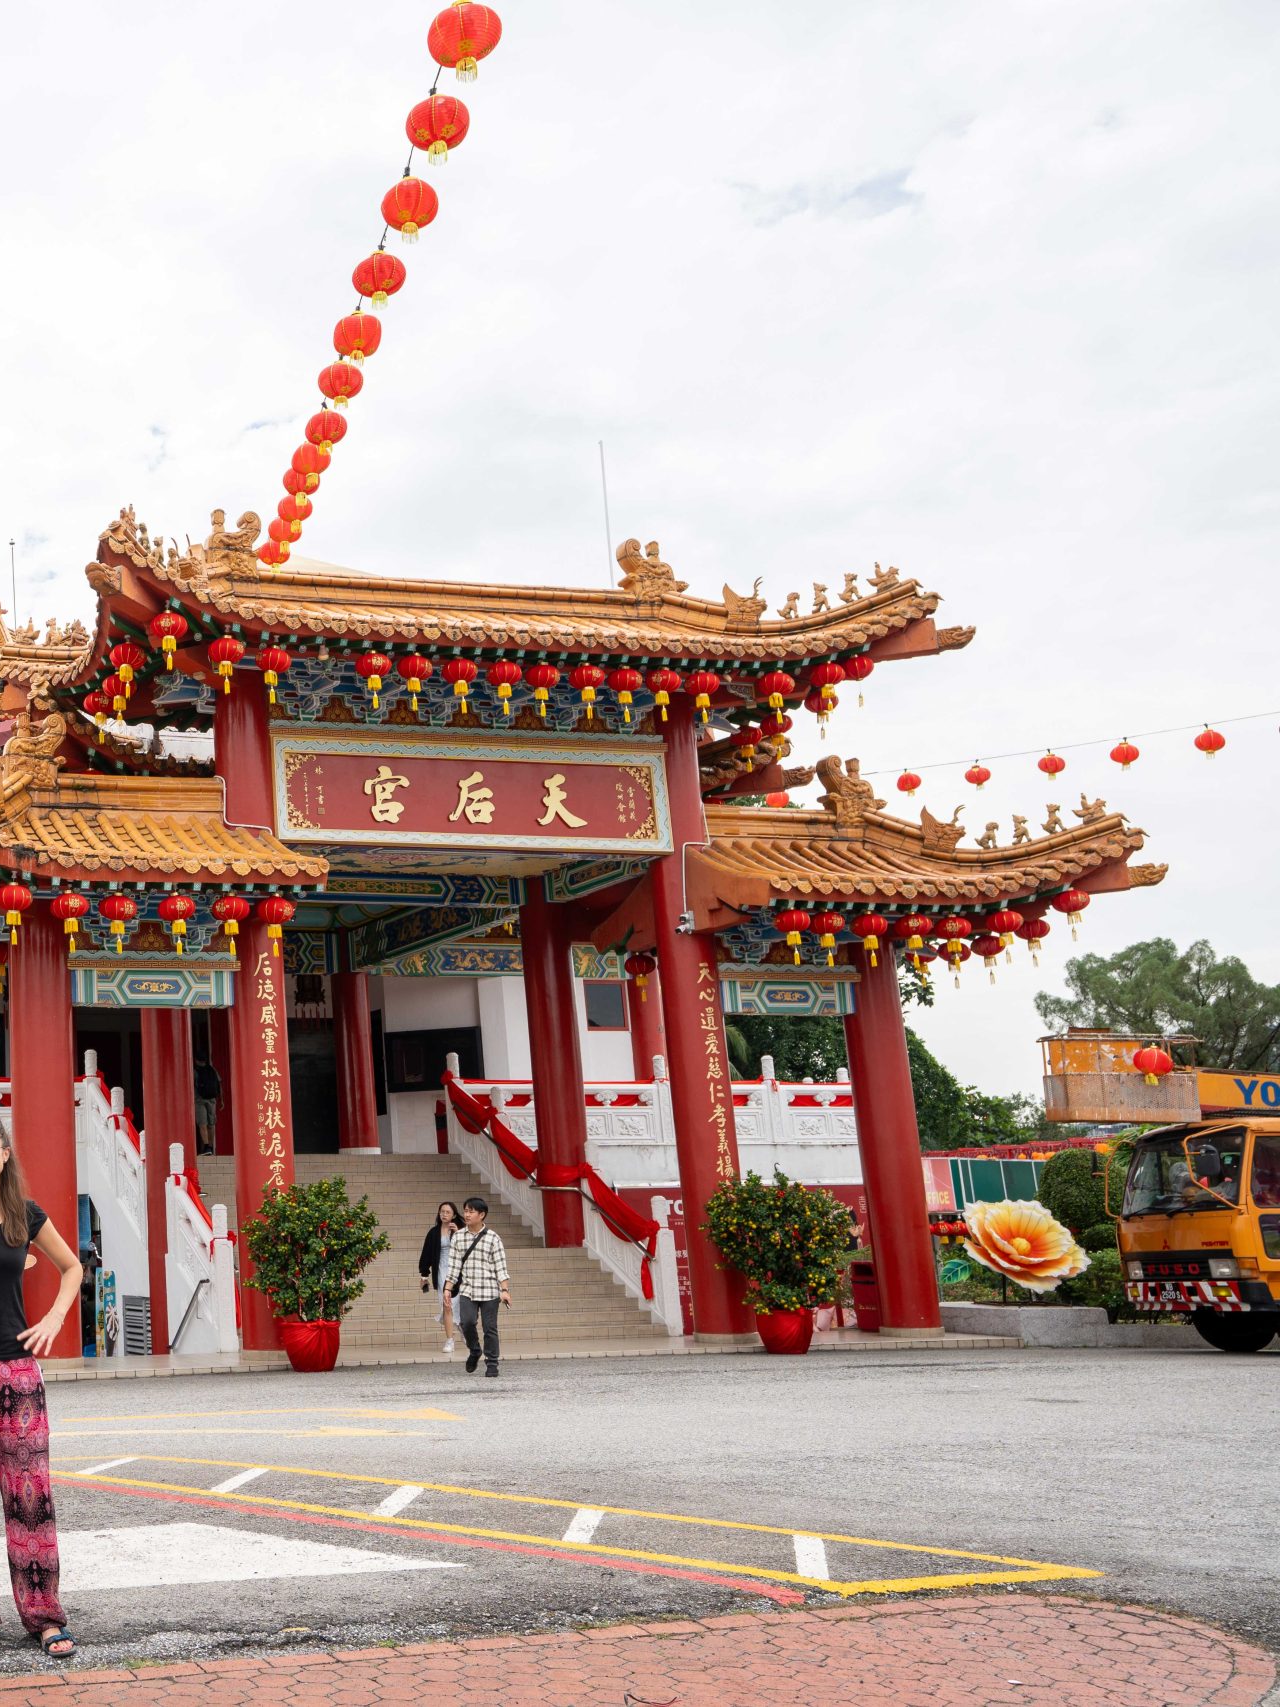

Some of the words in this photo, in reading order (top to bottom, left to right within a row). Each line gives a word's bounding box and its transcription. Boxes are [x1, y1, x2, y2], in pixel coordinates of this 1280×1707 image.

[697, 962, 734, 1186] 天心遺愛慈仁孝義揚
[922, 1191, 951, 1205] FFICE
[1146, 1263, 1200, 1276] FUSO
